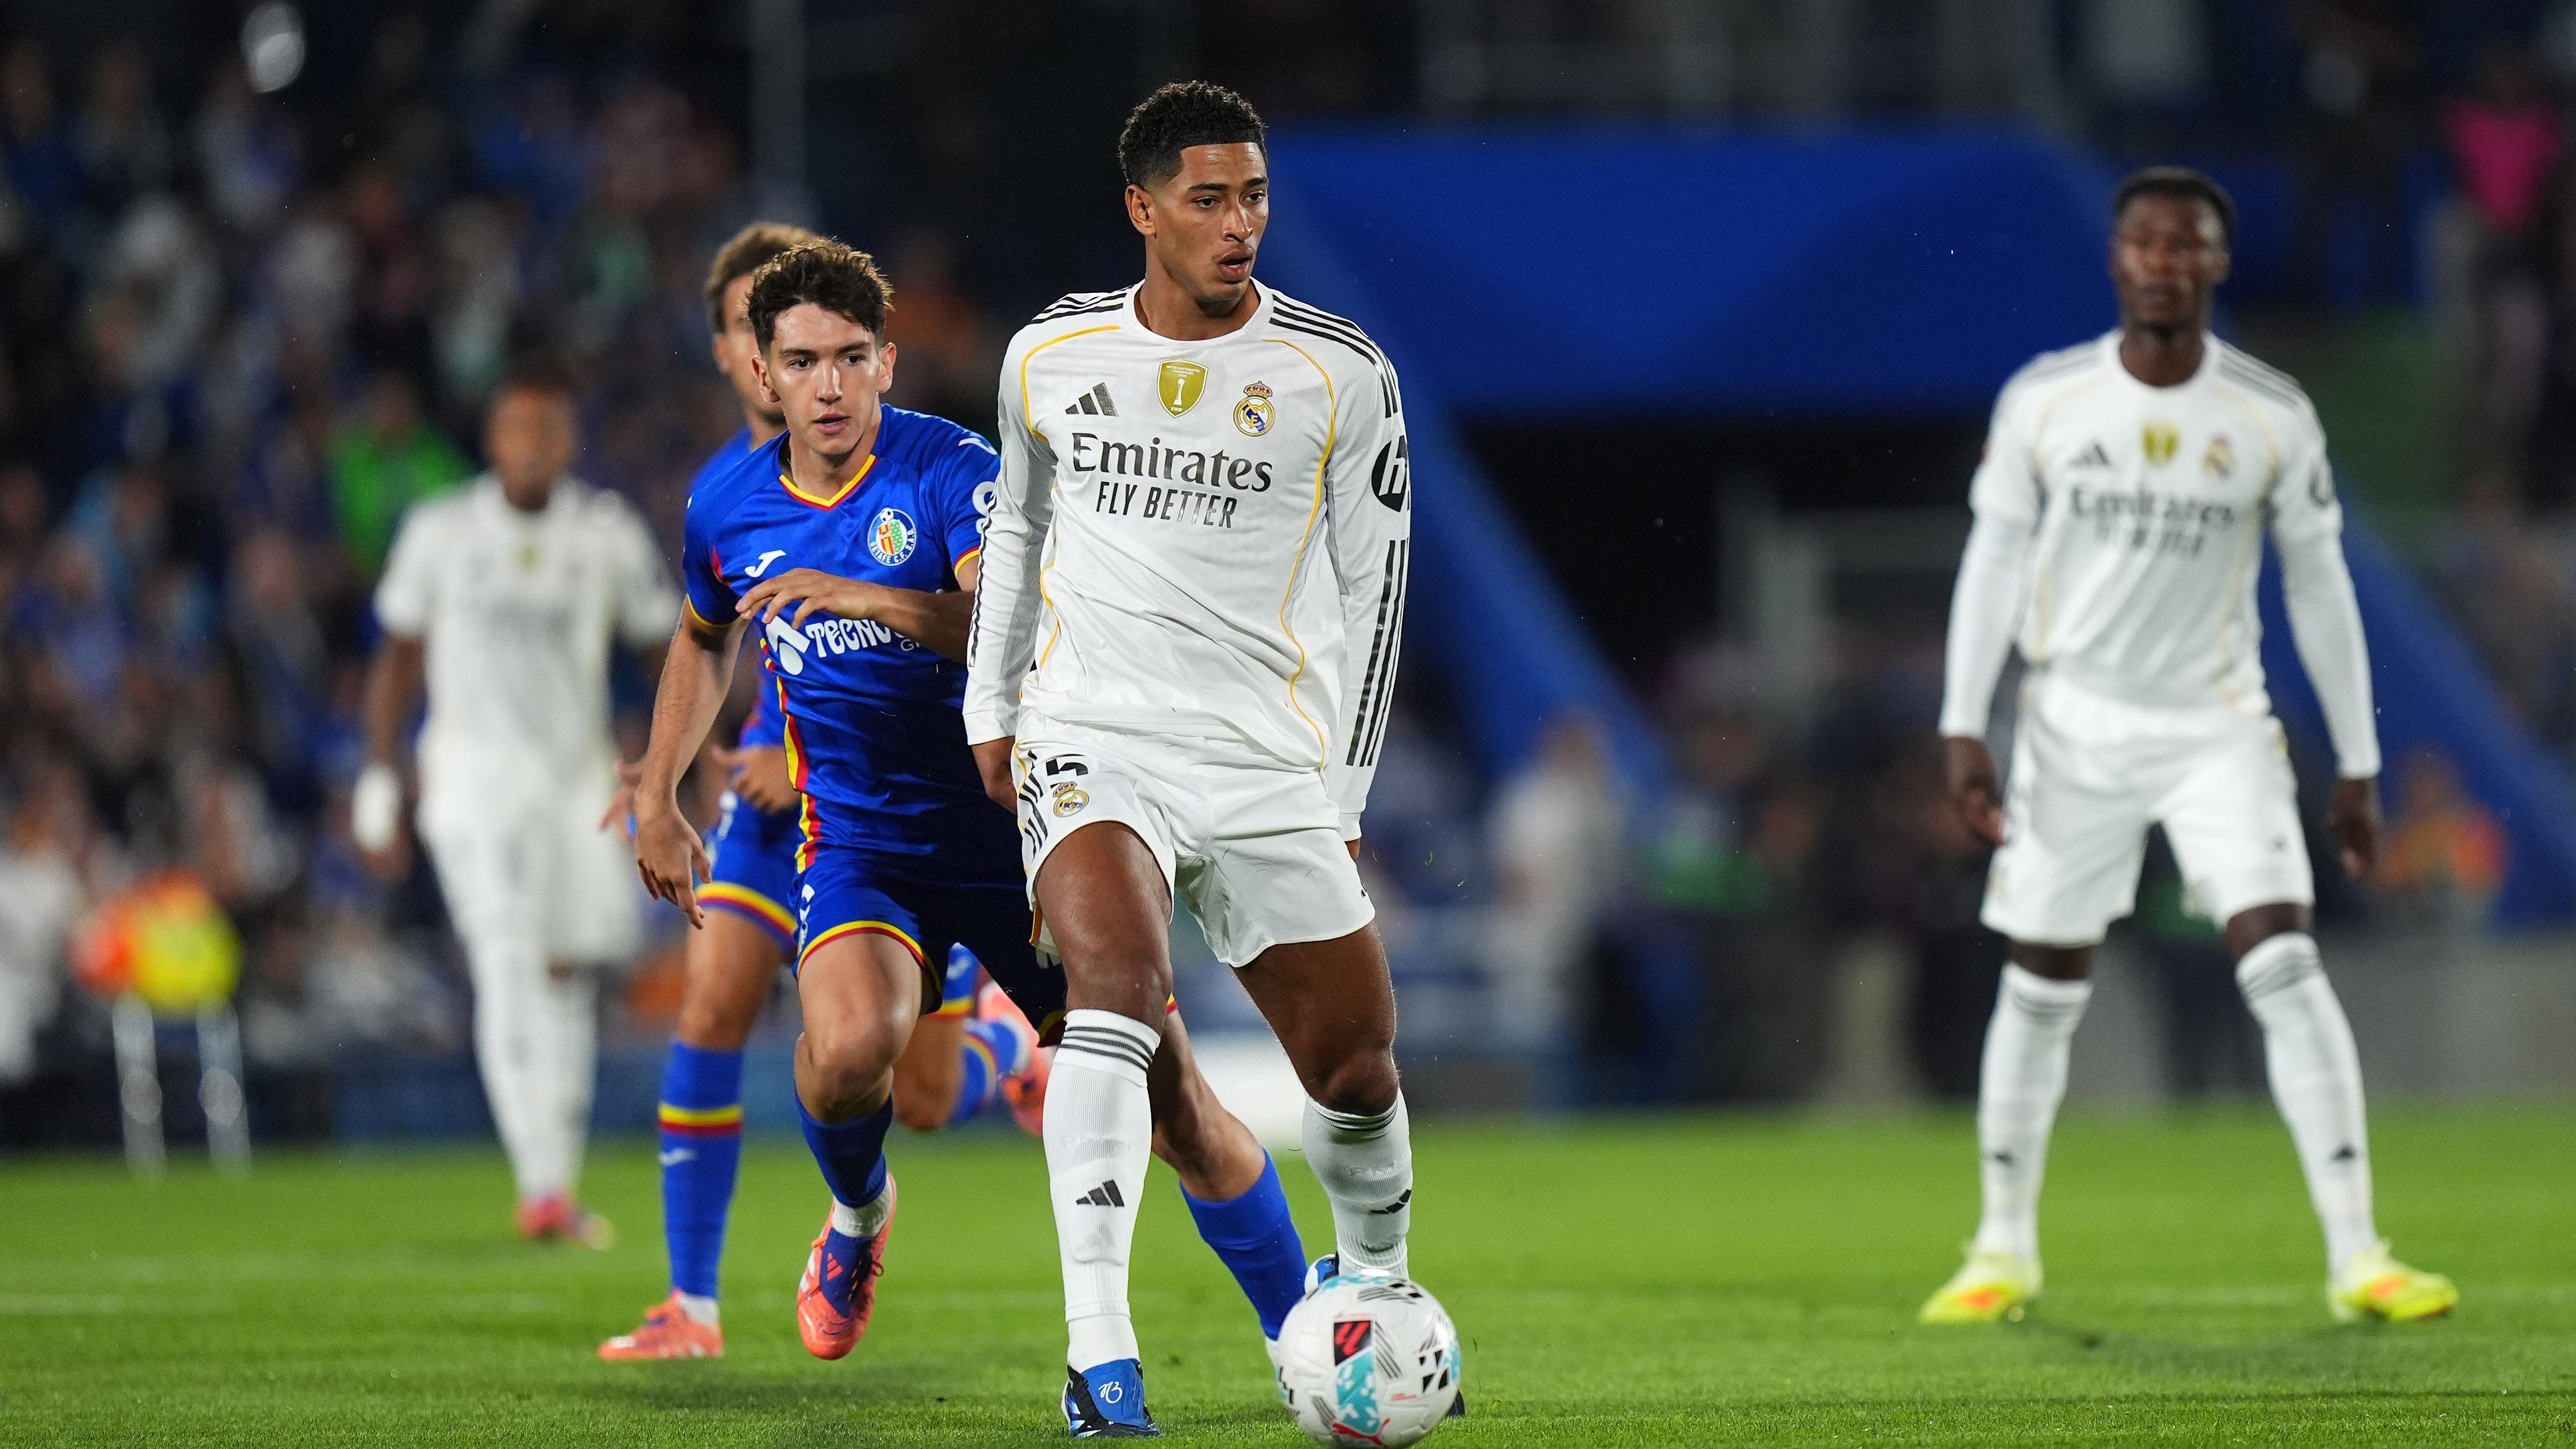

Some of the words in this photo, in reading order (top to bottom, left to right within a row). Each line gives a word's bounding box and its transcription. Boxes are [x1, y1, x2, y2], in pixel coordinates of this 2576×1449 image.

[1071, 432, 1273, 492] Emirates
[1096, 481, 1138, 516] FLY
[1143, 486, 1238, 529] BETTER
